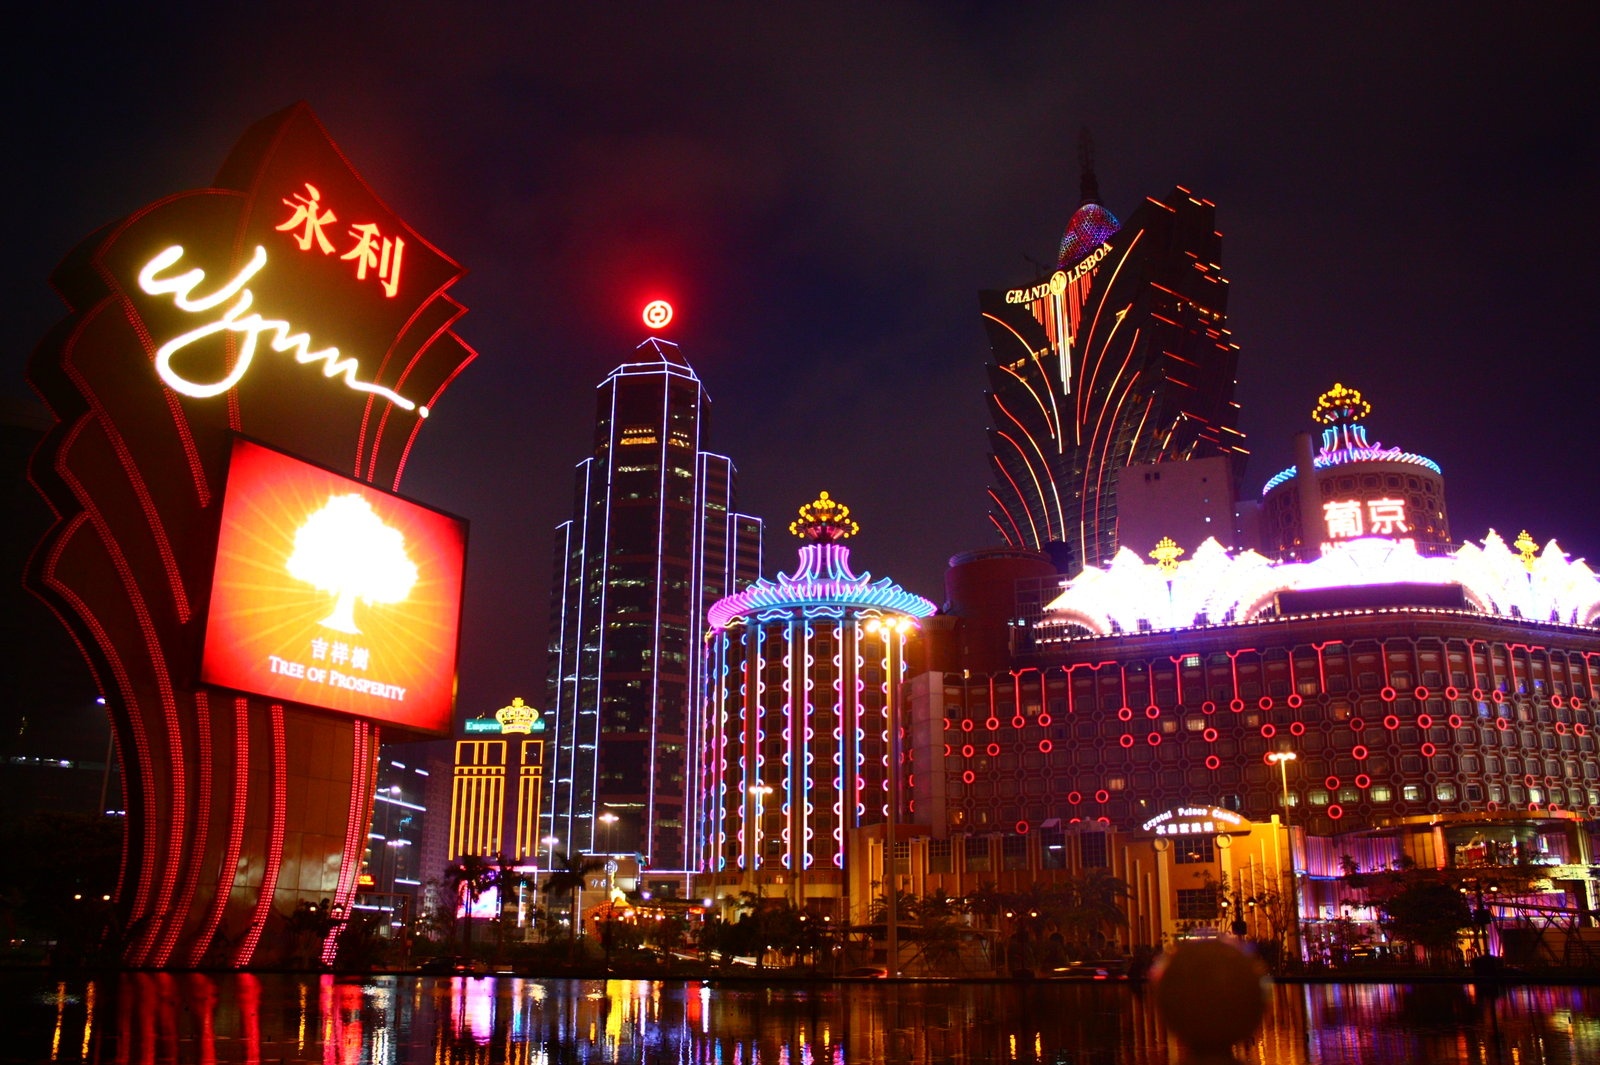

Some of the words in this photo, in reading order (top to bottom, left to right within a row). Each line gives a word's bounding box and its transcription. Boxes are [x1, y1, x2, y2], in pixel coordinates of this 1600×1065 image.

[275, 182, 404, 298] 永利
[1005, 283, 1051, 304] GRAND
[1067, 242, 1113, 284] LISBOA
[1323, 497, 1408, 538] 葡京
[311, 636, 370, 671] 吉祥樹
[268, 655, 304, 679] TREE
[307, 667, 327, 683] OF
[329, 670, 406, 701] PROSPERITY
[1142, 810, 1173, 831] Crystal
[1177, 807, 1208, 817] Palace
